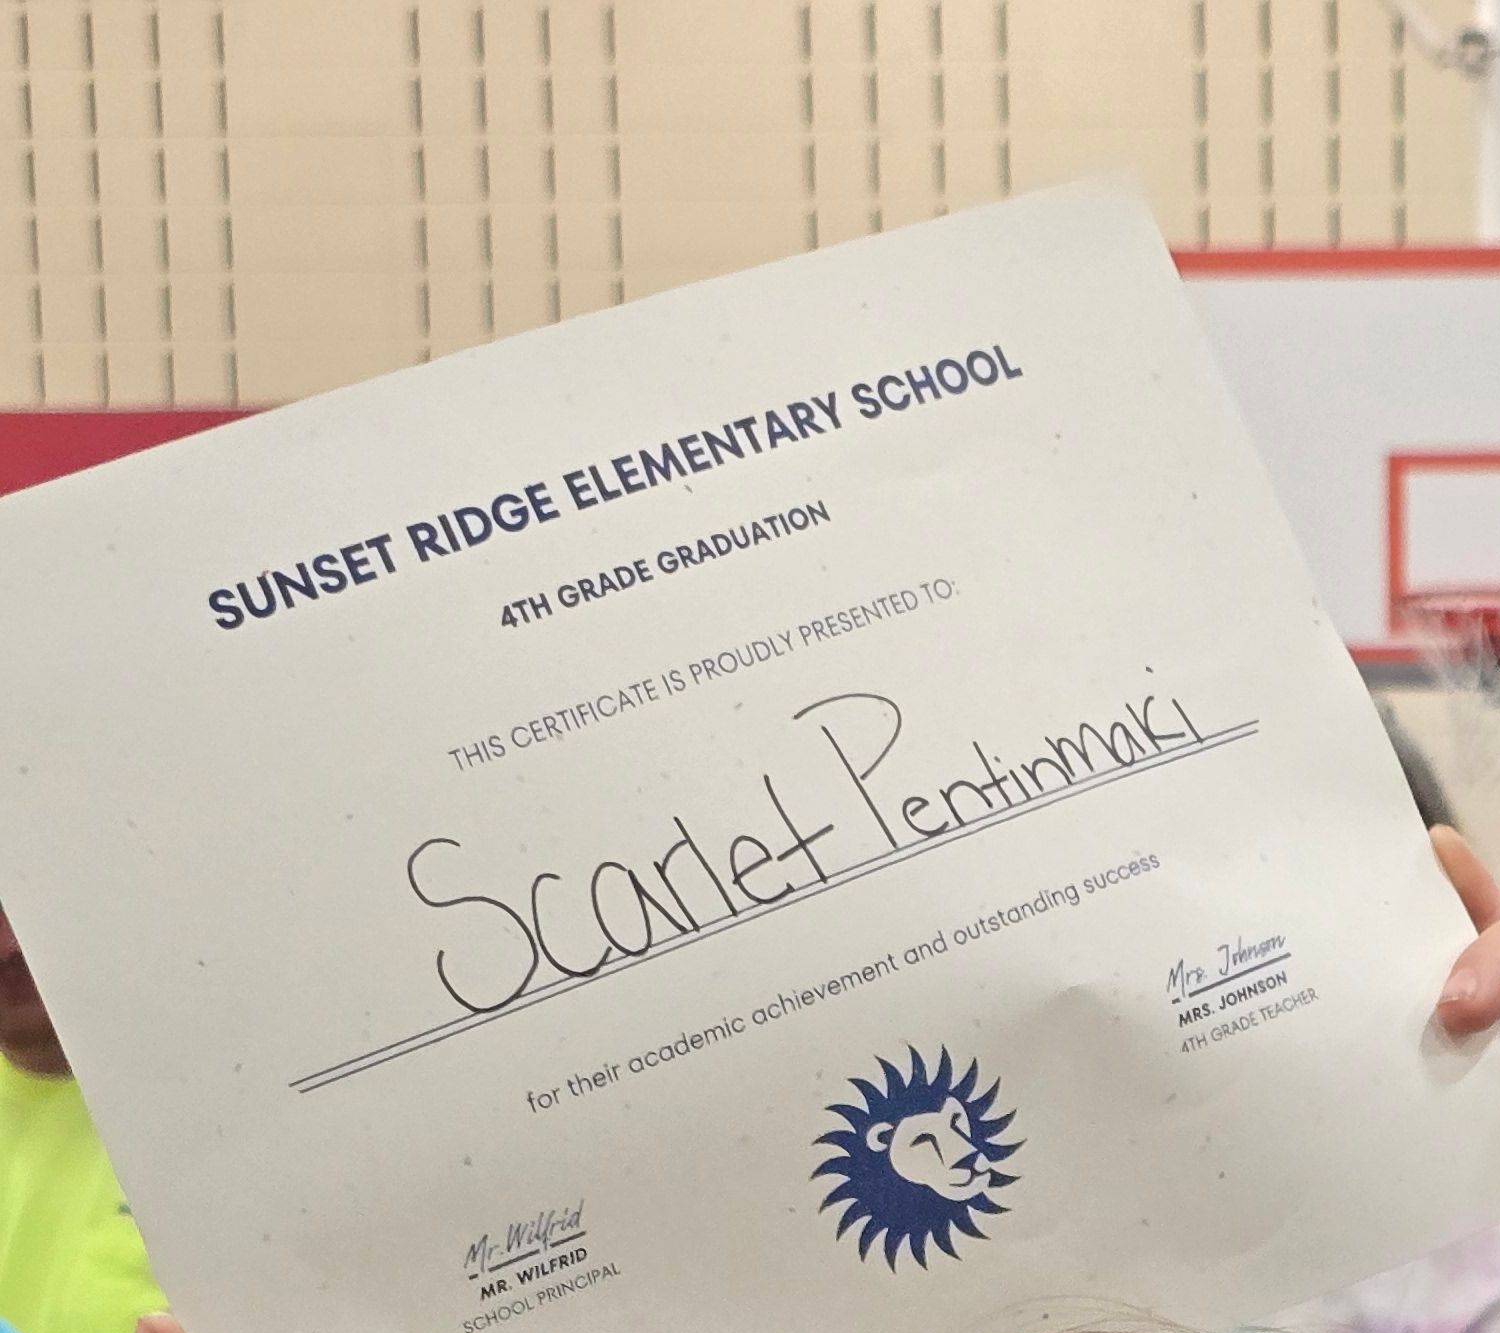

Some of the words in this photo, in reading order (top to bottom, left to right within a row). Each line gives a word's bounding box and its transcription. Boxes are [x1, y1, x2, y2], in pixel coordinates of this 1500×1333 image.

[208, 533, 398, 630] SUNSET
[406, 482, 560, 562] RIDGE
[562, 391, 843, 510] ELEMENTARY
[851, 345, 1023, 419] SCHOOL
[501, 593, 552, 628] 4TH
[557, 559, 654, 608] GRADE
[657, 500, 831, 574] GRADUATION
[448, 735, 506, 772] THIS
[510, 678, 660, 749] CERTIFICATE
[662, 669, 686, 697] IS
[688, 630, 795, 684] PROUDLY
[799, 589, 919, 646] PRESENTED
[919, 578, 961, 606] TO:
[406, 774, 835, 1013] Scarlet
[794, 667, 1204, 849] Pentinmaki
[526, 1087, 561, 1114] for
[567, 1062, 621, 1096] their
[629, 1015, 746, 1075] academic
[752, 953, 898, 1026] achievement
[904, 930, 947, 966] and
[953, 881, 1080, 945] outstanding
[1083, 851, 1161, 895] success
[1179, 1003, 1215, 1028] MRS.
[1219, 970, 1288, 1010] JOHNSON
[1217, 935, 1286, 976] Johnson
[1181, 1034, 1208, 1054] 4TH
[1211, 1011, 1259, 1042] GRADE
[1259, 988, 1320, 1022] TEACHER
[480, 1279, 513, 1302] MR.
[516, 1248, 588, 1285] WILFRID
[536, 1262, 621, 1306] PRINCIPAL
